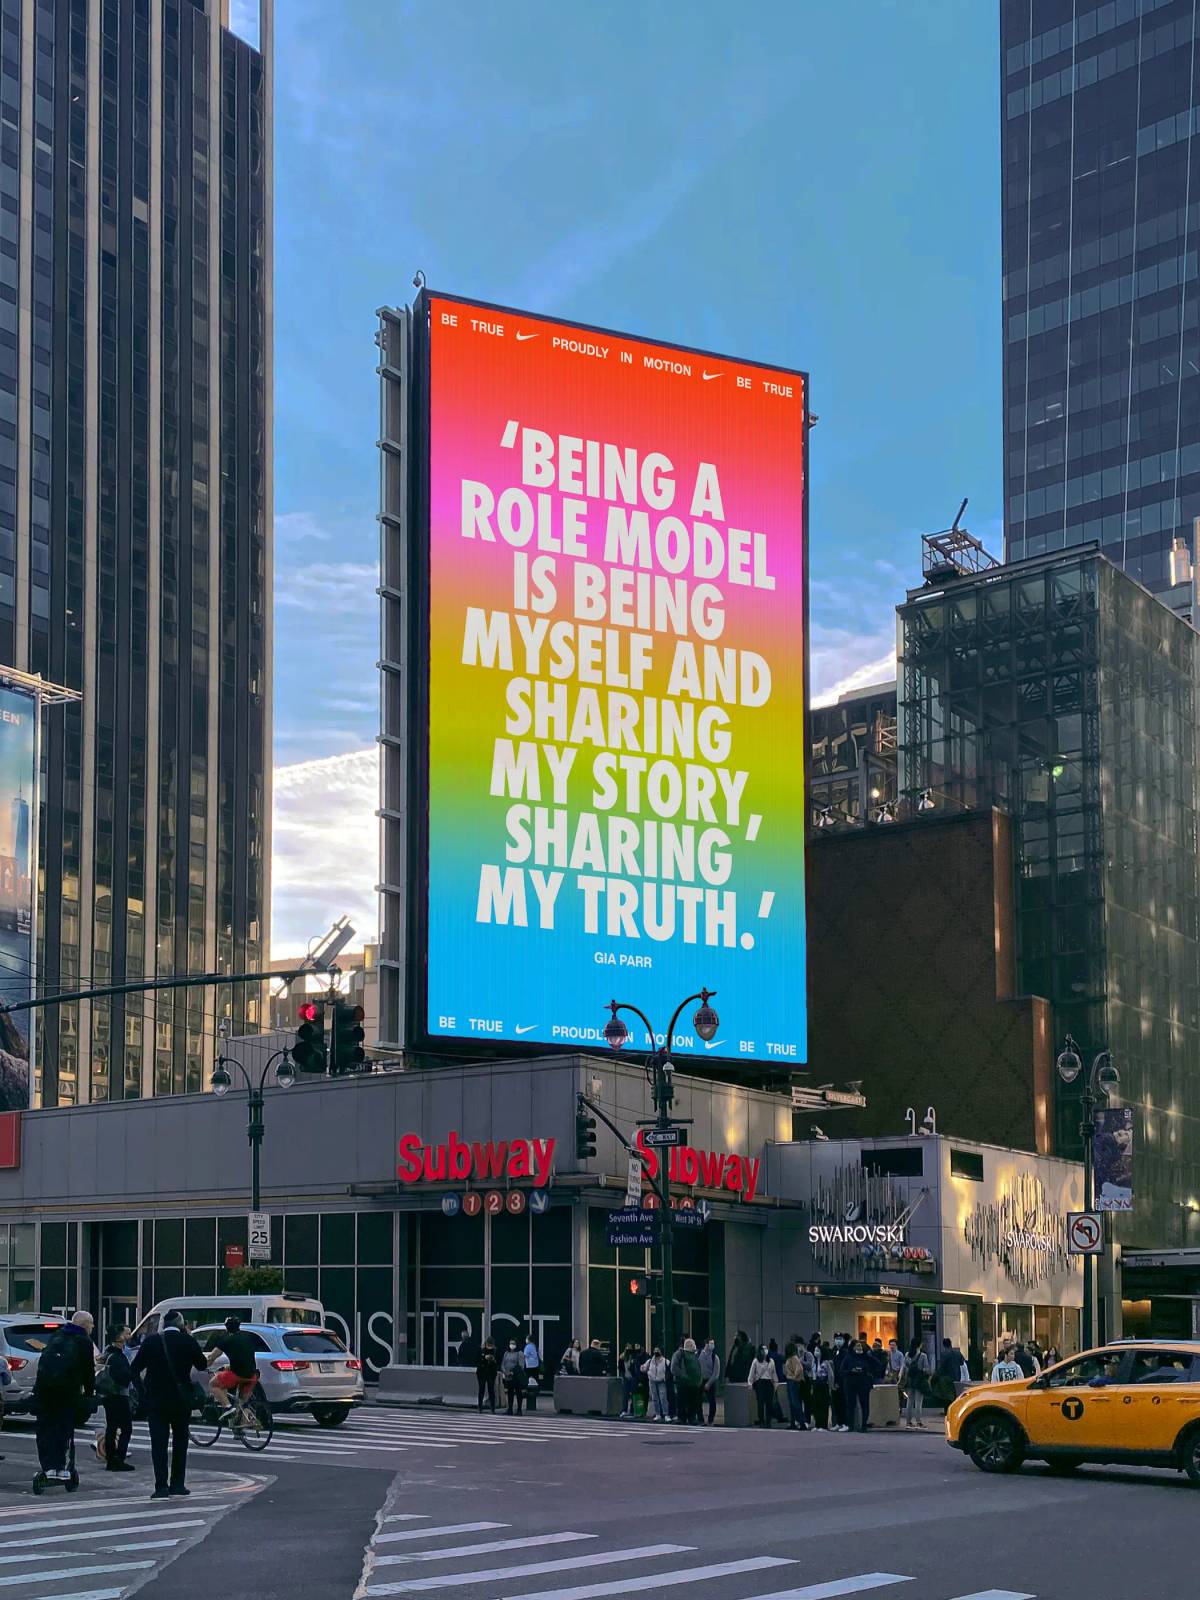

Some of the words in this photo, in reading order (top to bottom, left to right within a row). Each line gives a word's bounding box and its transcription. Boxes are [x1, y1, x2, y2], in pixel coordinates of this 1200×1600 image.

[441, 313, 458, 327] BE
[471, 320, 504, 337] TRUE
[552, 337, 609, 359] PROUDLY
[620, 352, 633, 364] IN
[643, 357, 692, 377] MOTION
[736, 376, 752, 390] BE
[763, 382, 793, 398] TRUE
[689, 462, 726, 522] A
[461, 479, 588, 558] ROLE
[603, 506, 776, 591] MODEL
[513, 552, 557, 615] IS
[574, 562, 726, 641] BEING
[461, 606, 654, 691] MYSELF
[667, 640, 772, 708] AND
[0, 709, 20, 725] EN
[505, 677, 733, 764] SHARING
[489, 738, 577, 805] MY
[592, 752, 764, 842] STORY,
[505, 803, 734, 886] SHARING
[475, 863, 565, 931] MY
[594, 951, 617, 966] GIA
[619, 954, 653, 969] PARR
[439, 1016, 456, 1030] BE
[469, 1018, 504, 1034] TRUE
[552, 1024, 608, 1041] PROUDL
[645, 1032, 694, 1048] MOION
[739, 1040, 755, 1053] BE
[766, 1042, 797, 1057] TRUE
[398, 1131, 556, 1187] Subway
[631, 1163, 639, 1173] NO
[442, 1197, 457, 1212] MTA
[469, 1196, 475, 1212] 1
[489, 1194, 499, 1211] 2
[511, 1193, 521, 1210] 3
[608, 1213, 638, 1223] Seventh
[640, 1213, 654, 1223] Ave
[675, 1213, 687, 1224] West
[251, 1230, 268, 1245] 25
[610, 1234, 638, 1244] Fashion
[640, 1234, 654, 1243] Ave
[808, 1225, 905, 1243] SWAROVSKI
[1007, 1231, 1056, 1252] SWAROVSKI
[880, 1286, 900, 1297] Subway
[1065, 1401, 1080, 1418] T
